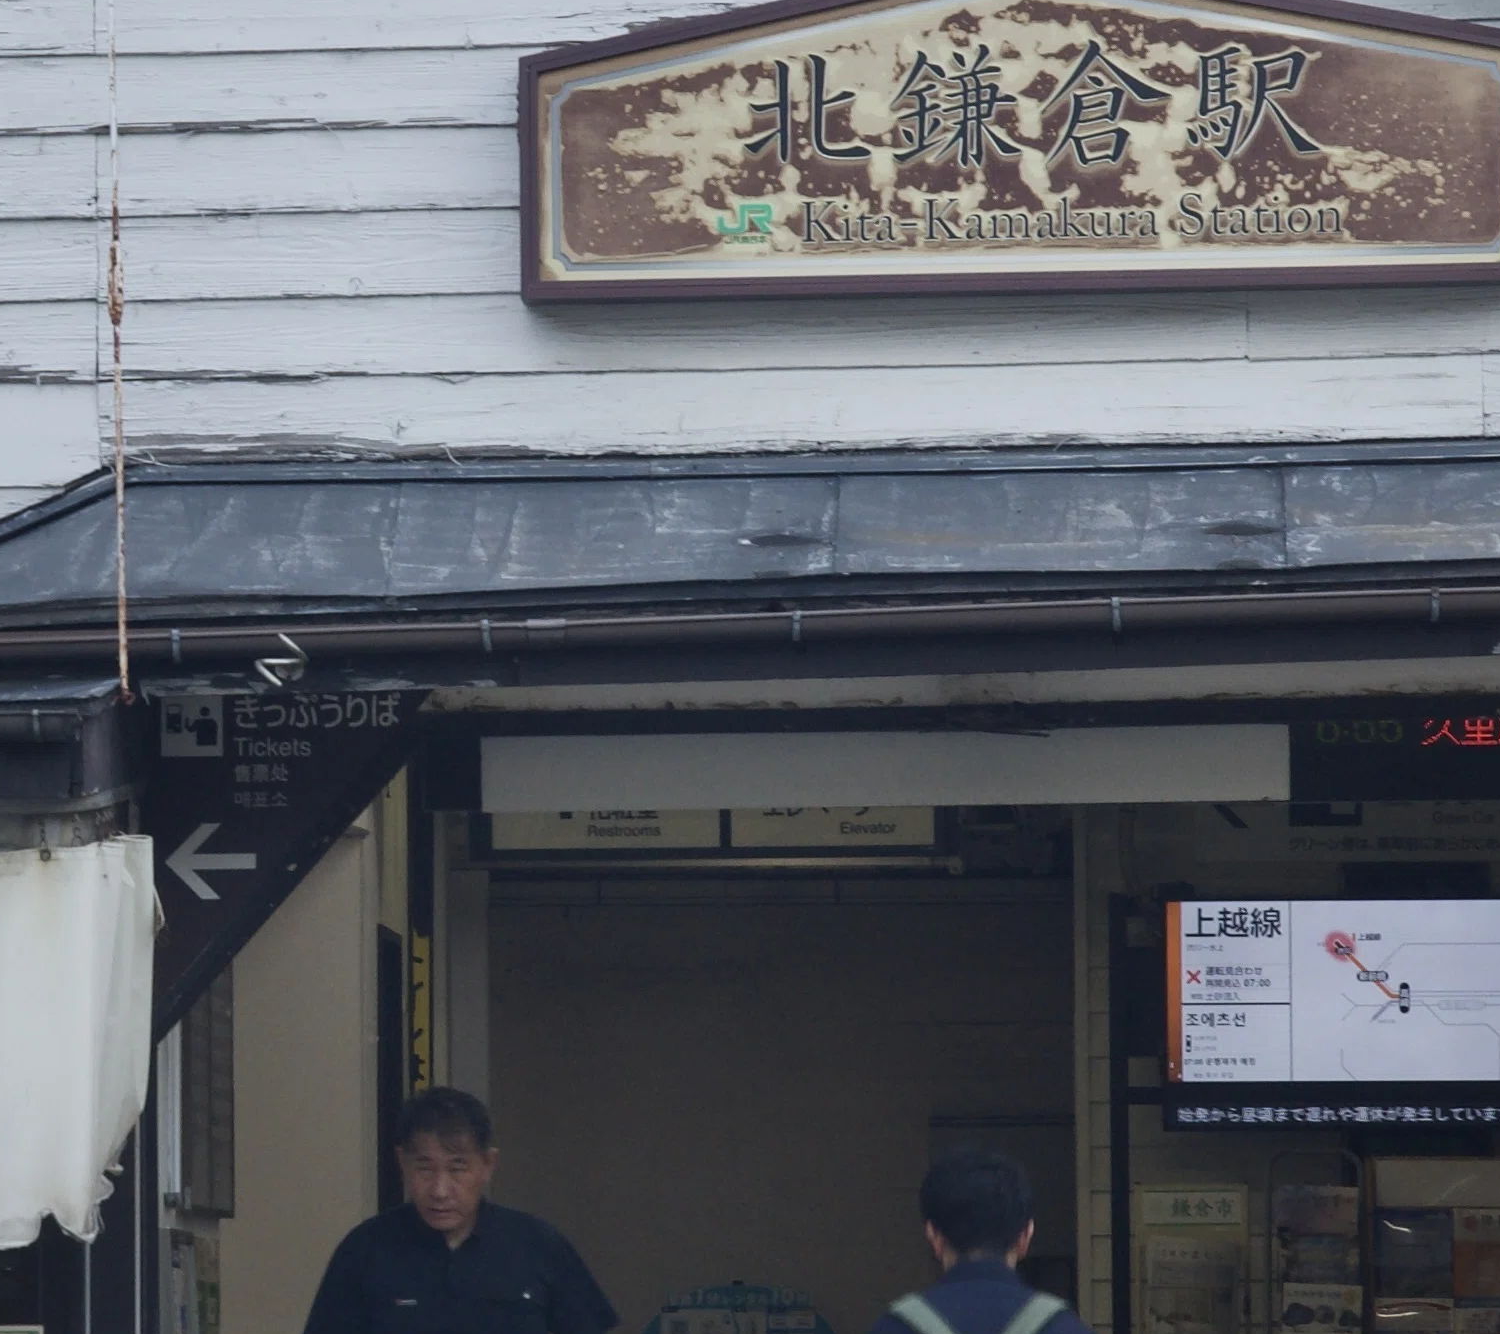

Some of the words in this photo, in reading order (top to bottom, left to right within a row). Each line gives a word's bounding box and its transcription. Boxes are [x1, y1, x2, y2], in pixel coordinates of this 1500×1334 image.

[744, 39, 1321, 167] 北鎌倉駅
[717, 203, 773, 234] JR
[802, 197, 1159, 242] Kita-Kamakura
[1177, 192, 1343, 237] Station
[233, 693, 401, 728] きっぷうりば
[233, 737, 312, 757] Tickets
[587, 823, 661, 838] Restrooms
[839, 820, 897, 835] Elevator
[1185, 907, 1282, 938] 上越線
[1243, 979, 1271, 987] 07:00
[1185, 1012, 1246, 1027] 조에츠선
